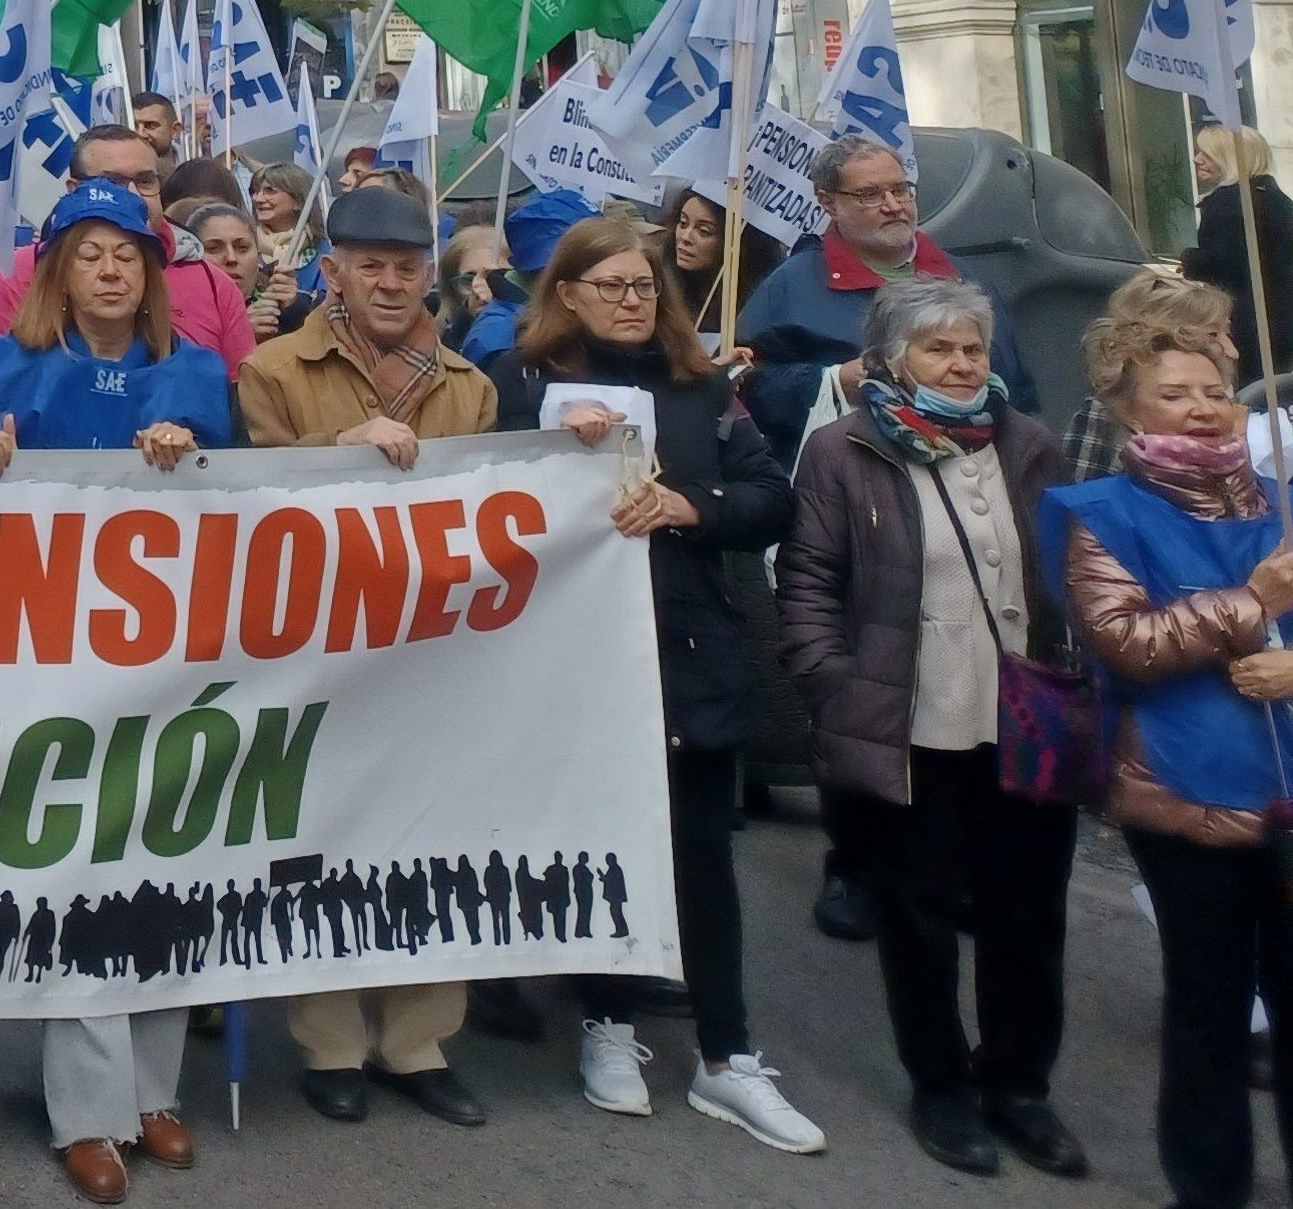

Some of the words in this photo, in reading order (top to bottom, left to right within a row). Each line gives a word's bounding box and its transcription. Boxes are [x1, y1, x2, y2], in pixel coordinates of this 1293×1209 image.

[549, 144, 565, 166] en
[570, 142, 583, 170] la
[95, 369, 127, 393] SAE
